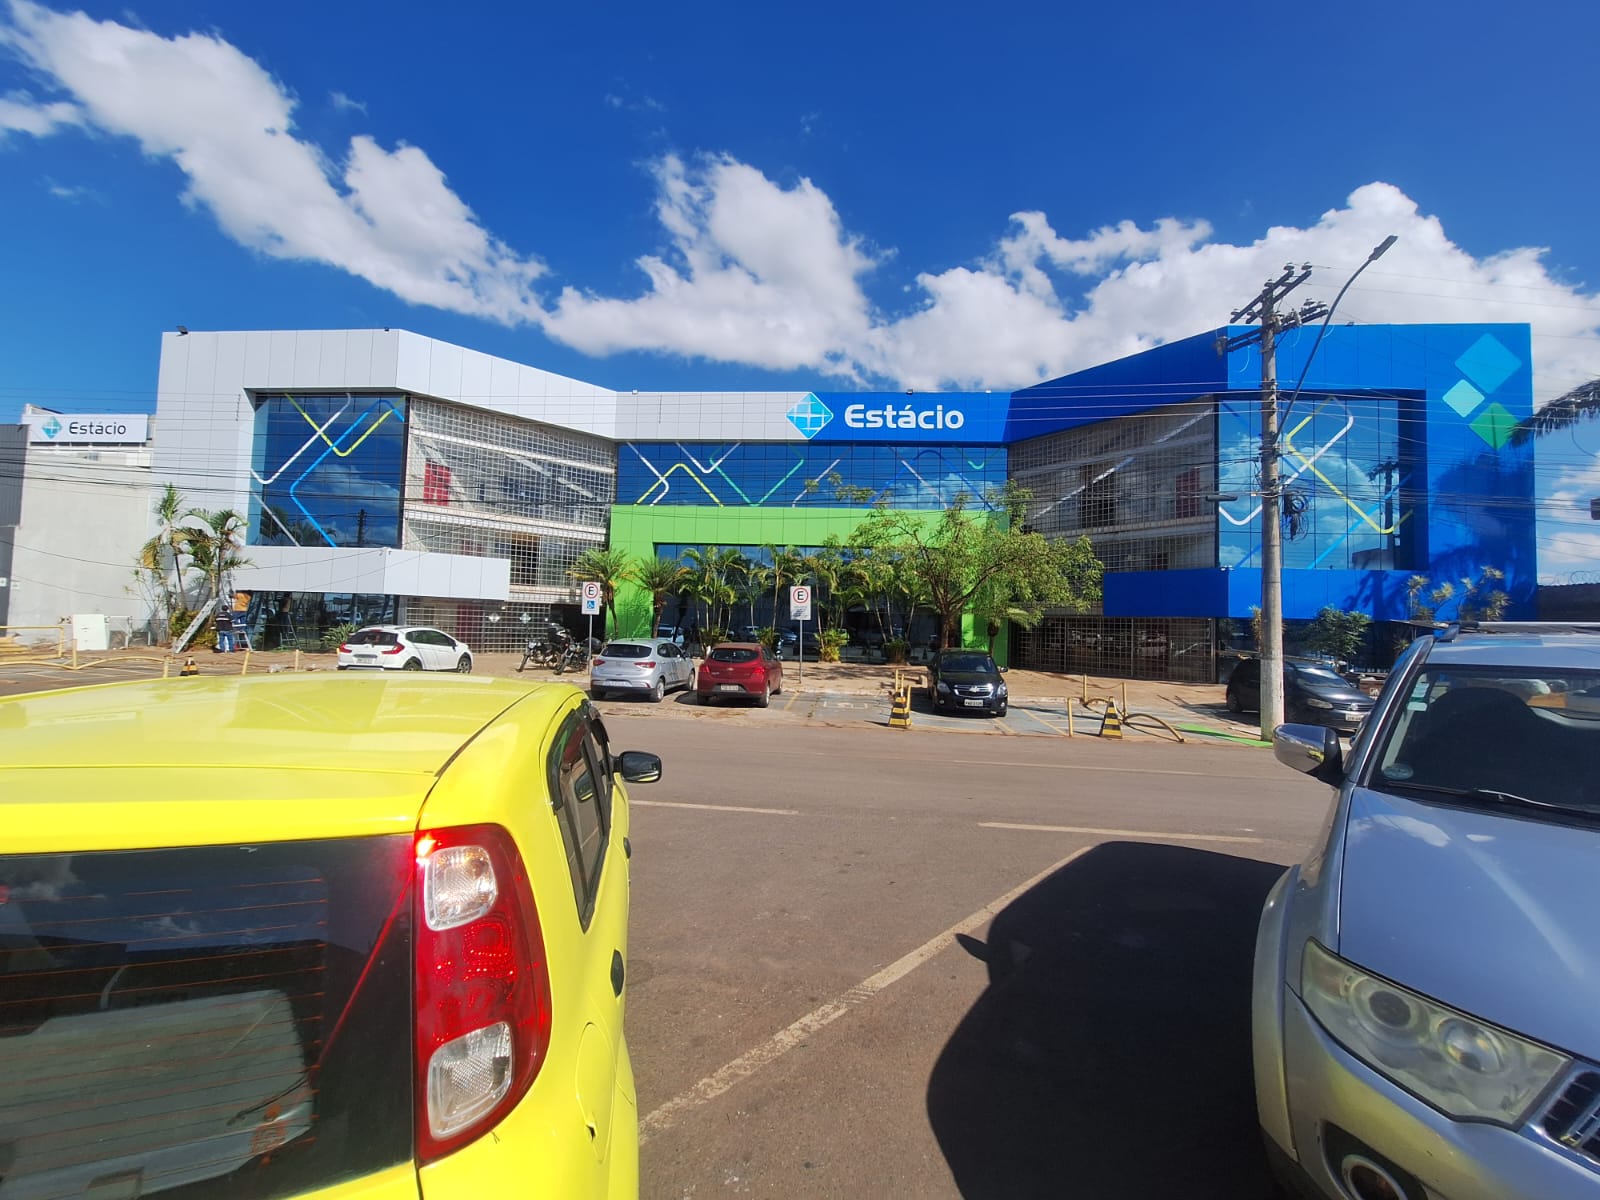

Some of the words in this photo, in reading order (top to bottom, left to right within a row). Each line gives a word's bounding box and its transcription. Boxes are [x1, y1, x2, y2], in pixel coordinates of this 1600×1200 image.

[844, 404, 964, 429] Estácio
[69, 421, 127, 435] Estácio
[588, 586, 595, 596] E
[797, 590, 805, 601] E
